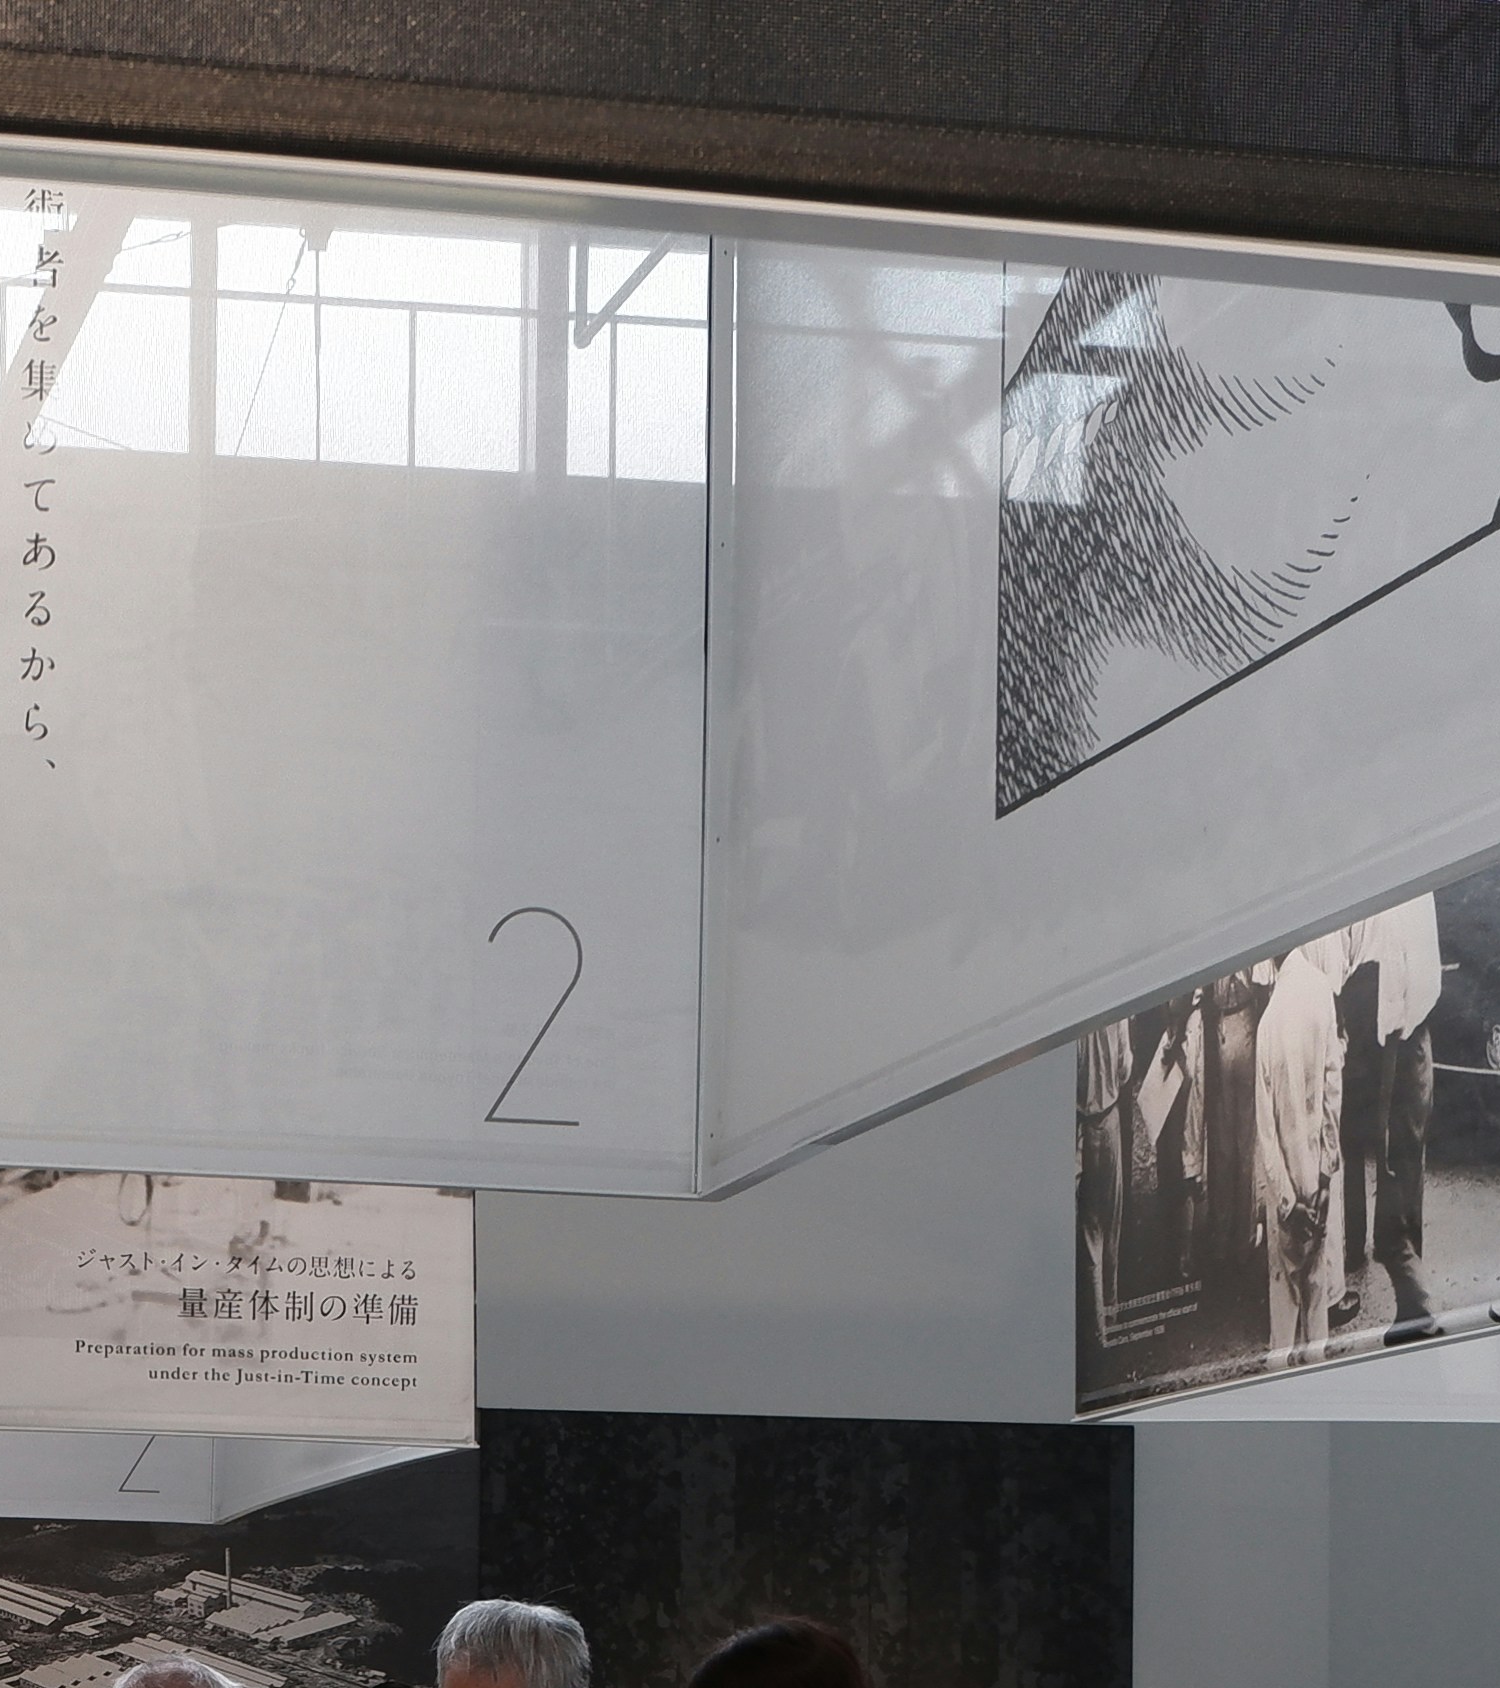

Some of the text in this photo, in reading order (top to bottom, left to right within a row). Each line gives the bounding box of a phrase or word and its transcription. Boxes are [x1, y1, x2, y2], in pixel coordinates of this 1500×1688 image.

[484, 906, 583, 1127] 2
[177, 1287, 420, 1327] 量産体制の準備
[74, 1339, 418, 1366] Preparation for mass production system
[148, 1367, 418, 1392] under the Just-in-Time concept
